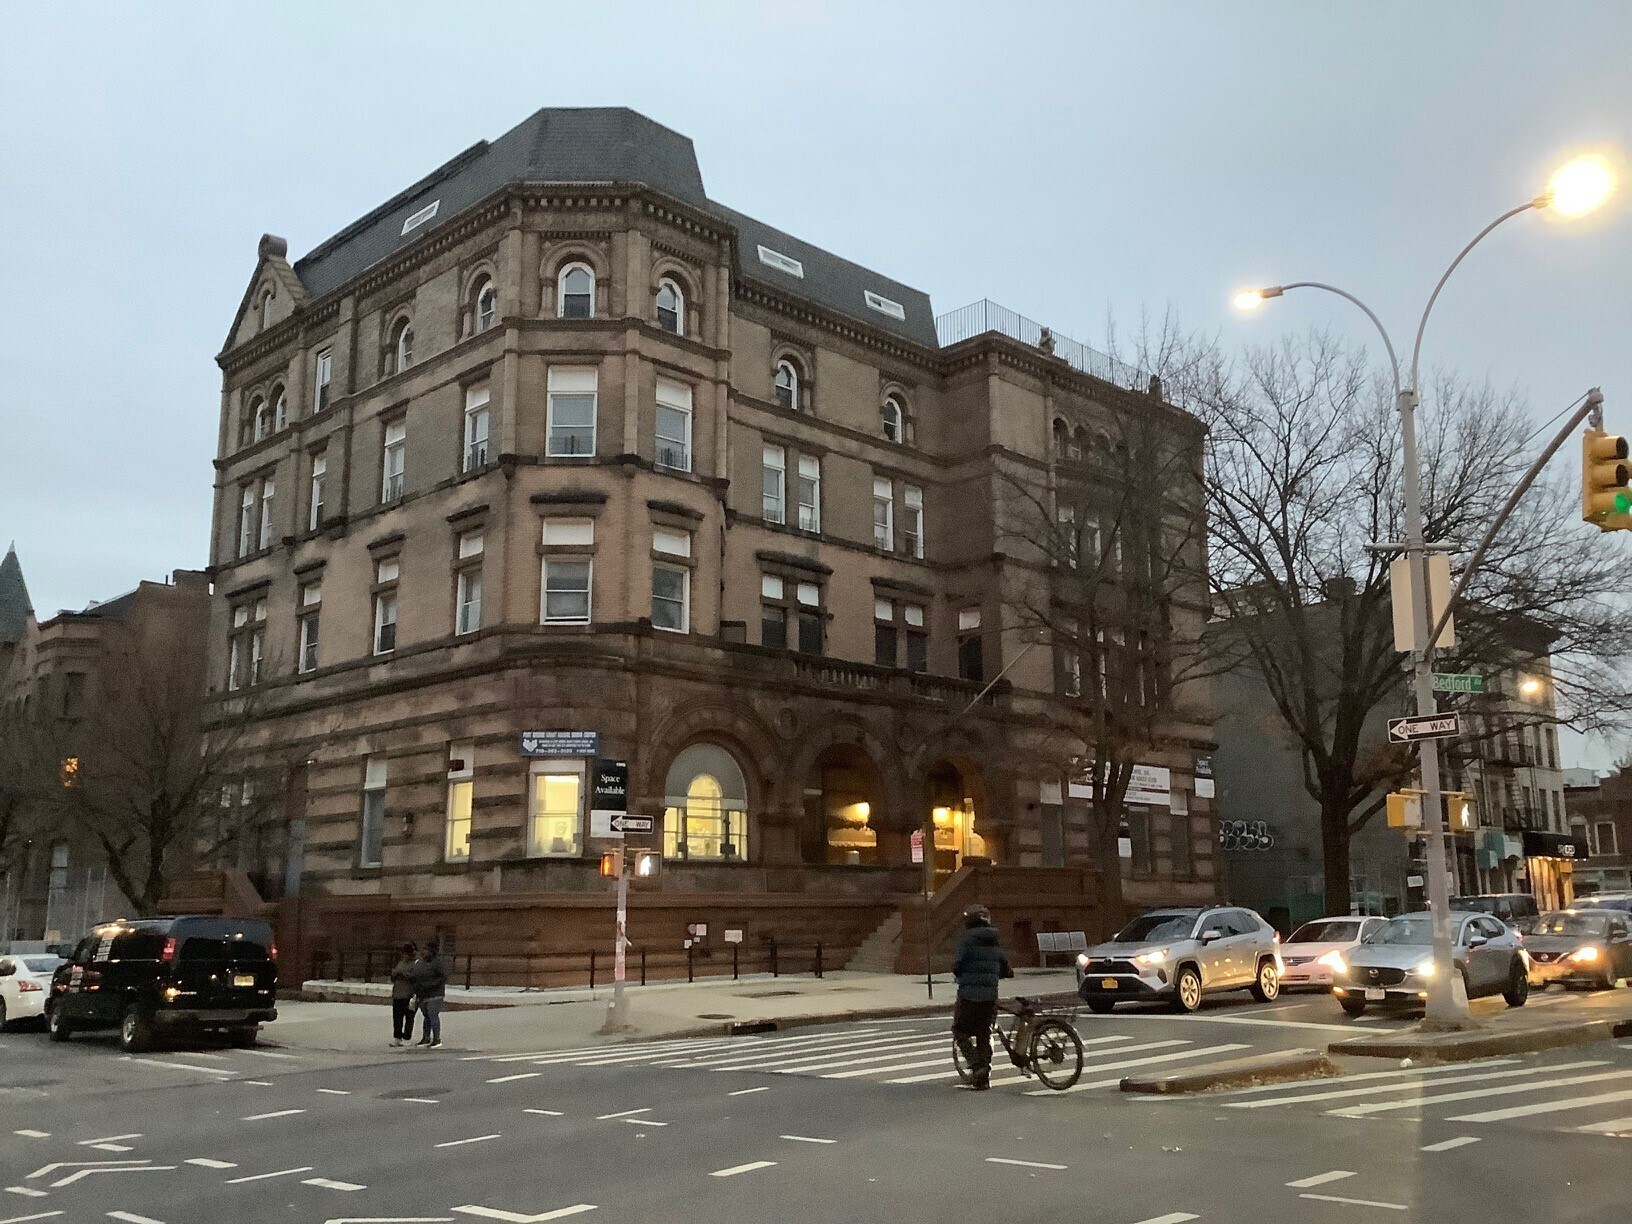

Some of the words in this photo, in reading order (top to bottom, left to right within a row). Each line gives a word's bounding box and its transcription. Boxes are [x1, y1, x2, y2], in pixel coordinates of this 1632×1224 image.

[1433, 676, 1471, 691] Bedford
[1397, 724, 1419, 735] ONE
[1429, 719, 1453, 731] WAY
[600, 773, 621, 784] Space
[594, 785, 626, 795] Available
[614, 819, 629, 828] ONE
[635, 820, 650, 828] WAY
